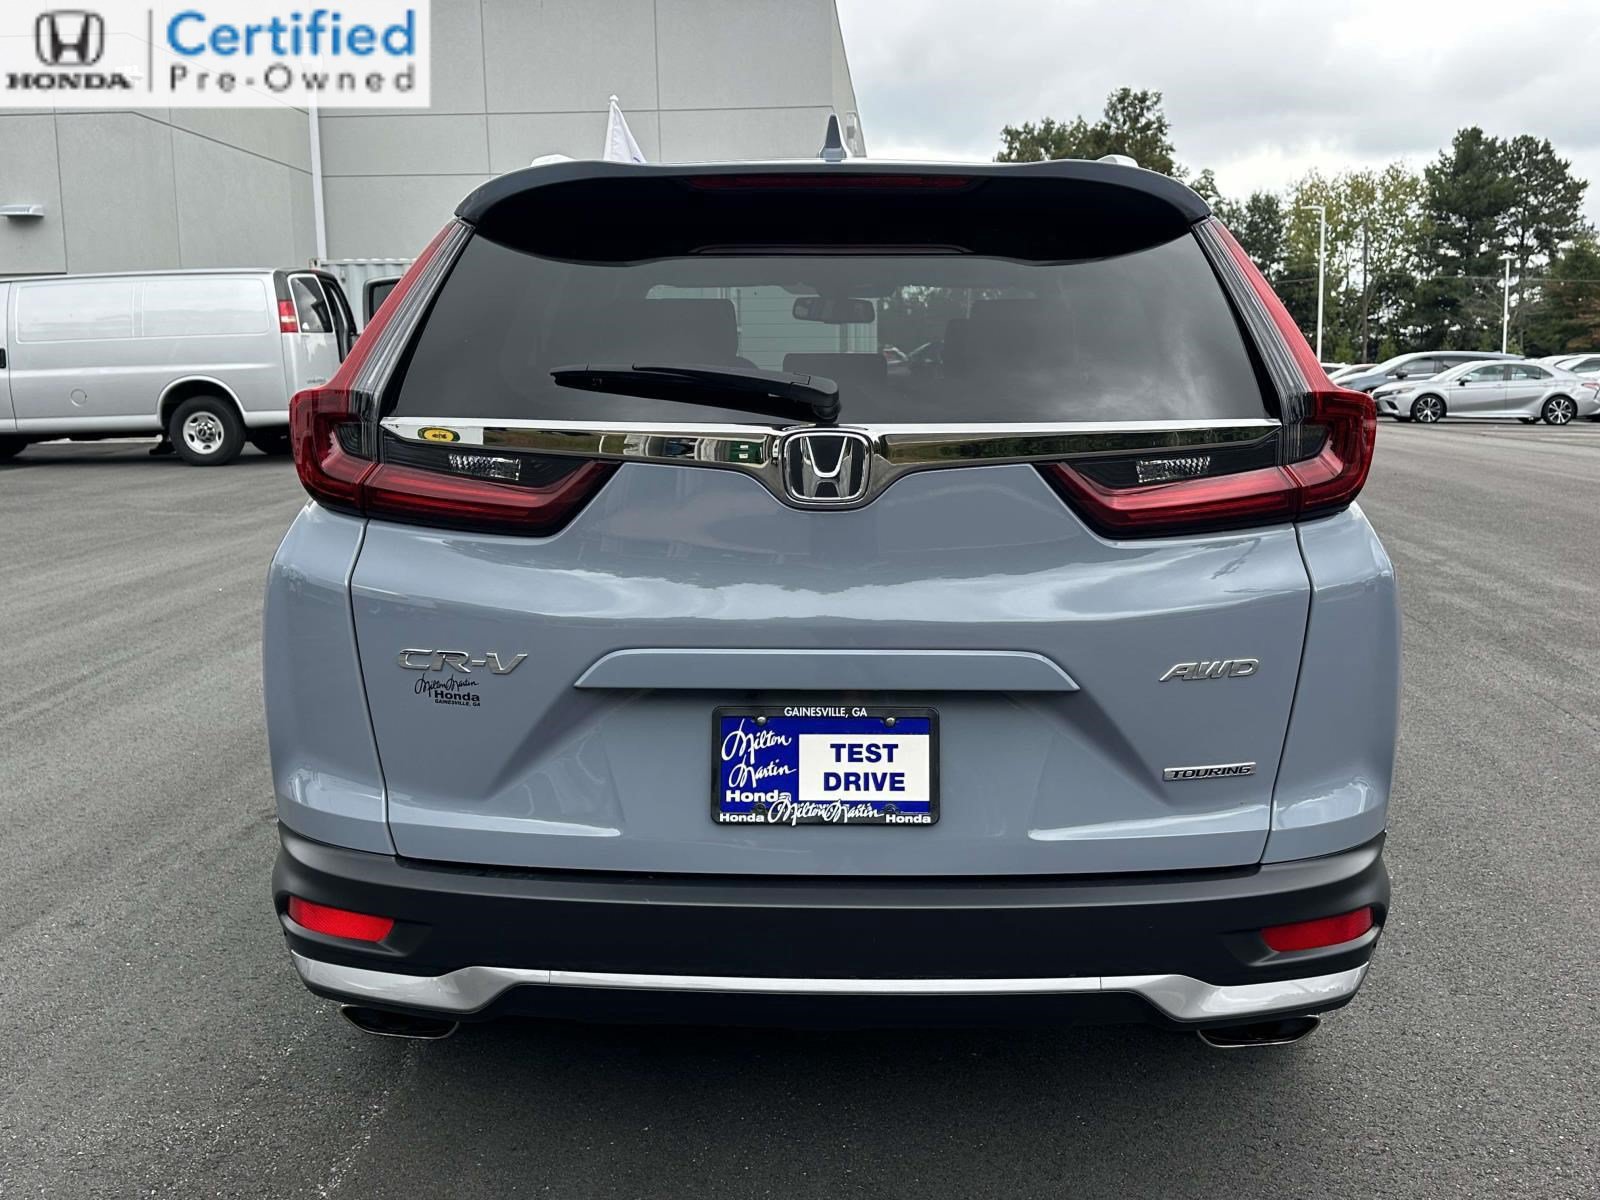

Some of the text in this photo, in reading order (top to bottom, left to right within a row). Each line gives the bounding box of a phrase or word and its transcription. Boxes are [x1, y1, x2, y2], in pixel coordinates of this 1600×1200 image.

[399, 648, 528, 675] CR-V
[1159, 658, 1259, 681] AWD
[434, 690, 480, 702] Honda
[784, 707, 867, 718] GAINESVILLE, GA
[721, 718, 792, 765] Milton
[830, 744, 899, 762] TEST
[728, 754, 797, 788] Martin
[1171, 765, 1252, 779] TOURING
[823, 772, 906, 792] DRIVE
[726, 790, 791, 802] Honda
[719, 813, 765, 822] Honda
[885, 814, 932, 824] Honda
